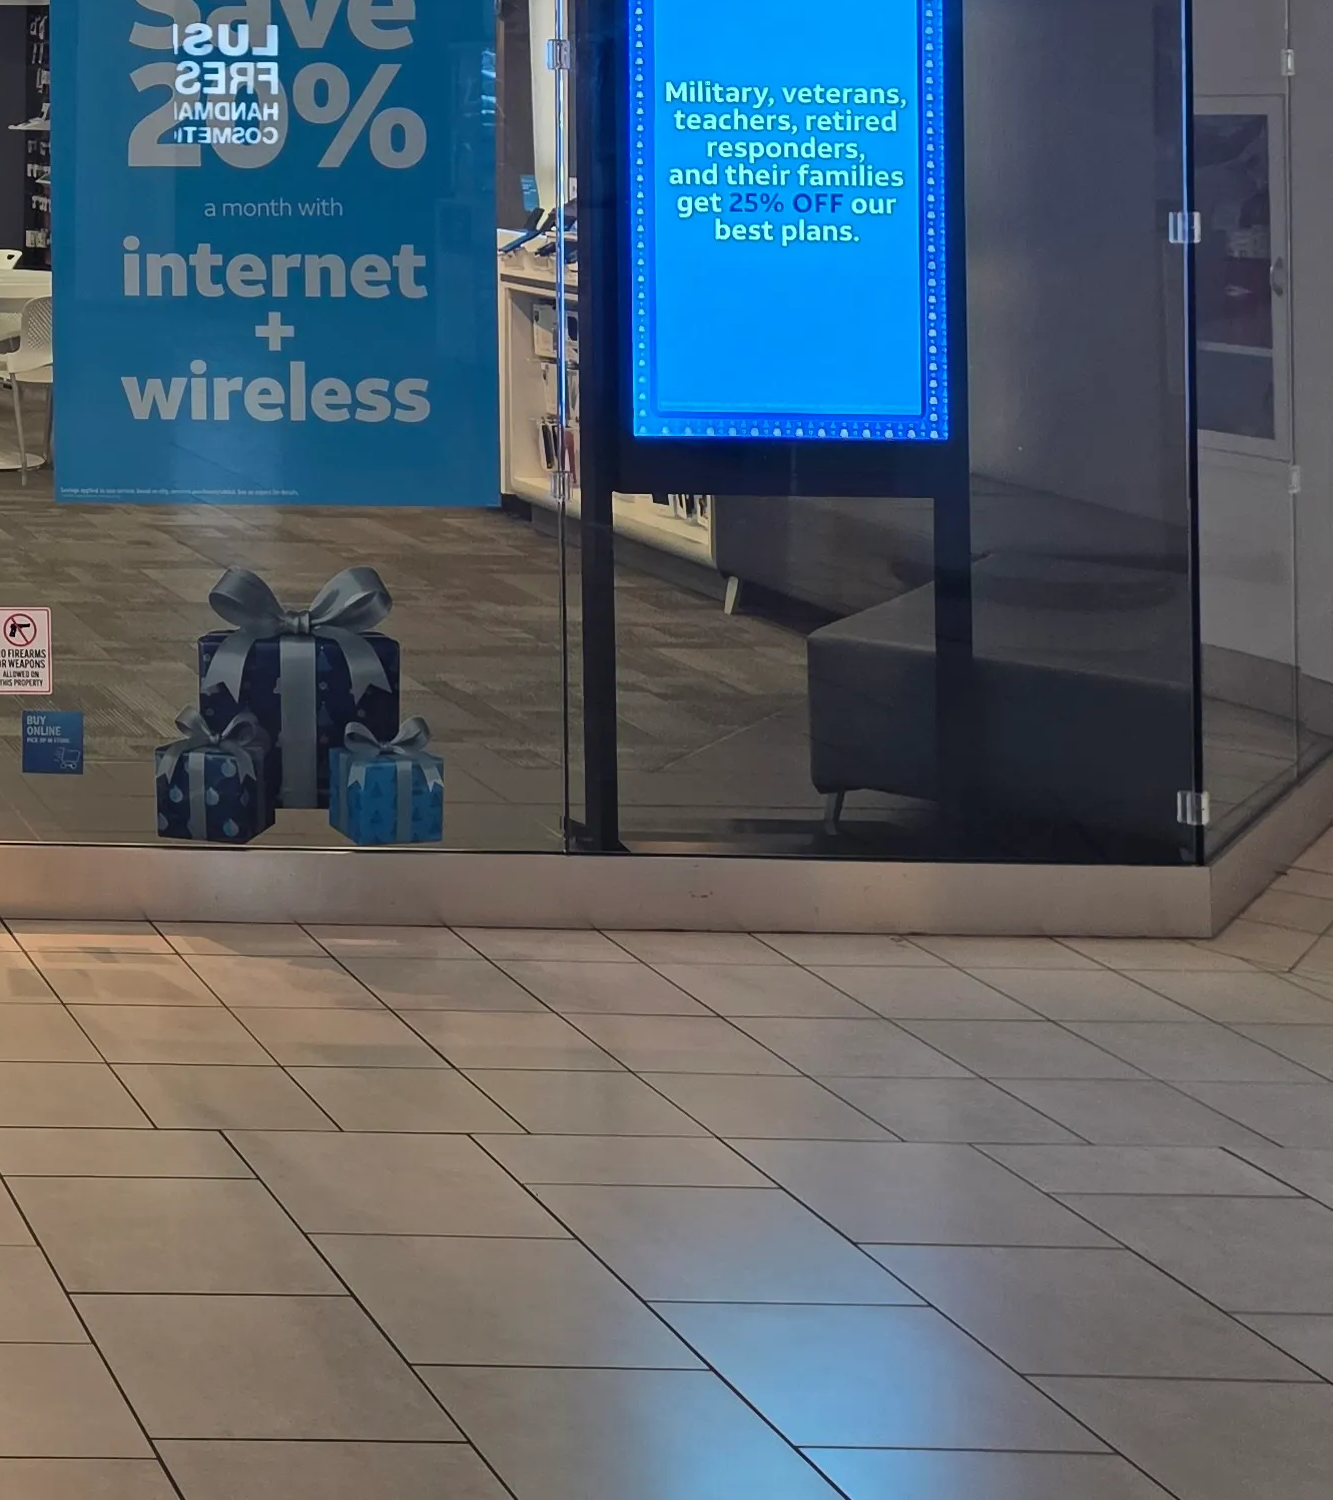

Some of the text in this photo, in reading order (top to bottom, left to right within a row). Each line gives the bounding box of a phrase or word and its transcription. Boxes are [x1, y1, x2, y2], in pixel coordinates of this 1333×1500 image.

[665, 80, 907, 109] Military, veterans,
[127, 62, 428, 168] 20%
[674, 108, 897, 134] teachers, retired
[707, 136, 865, 163] responders,
[669, 163, 904, 187] and their families
[204, 197, 343, 218] a month with
[677, 192, 897, 218] get 25% OFF our
[715, 217, 860, 247] best plans.
[122, 235, 429, 299] internet
[120, 359, 431, 424] wireless
[8, 649, 46, 659] FIREARMS
[8, 659, 46, 669] WEAPONS
[0, 679, 44, 687] THIS PROPERTY
[2, 670, 40, 678] ALLOWED ON
[26, 716, 46, 725] BUY
[26, 726, 61, 736] ONLINE
